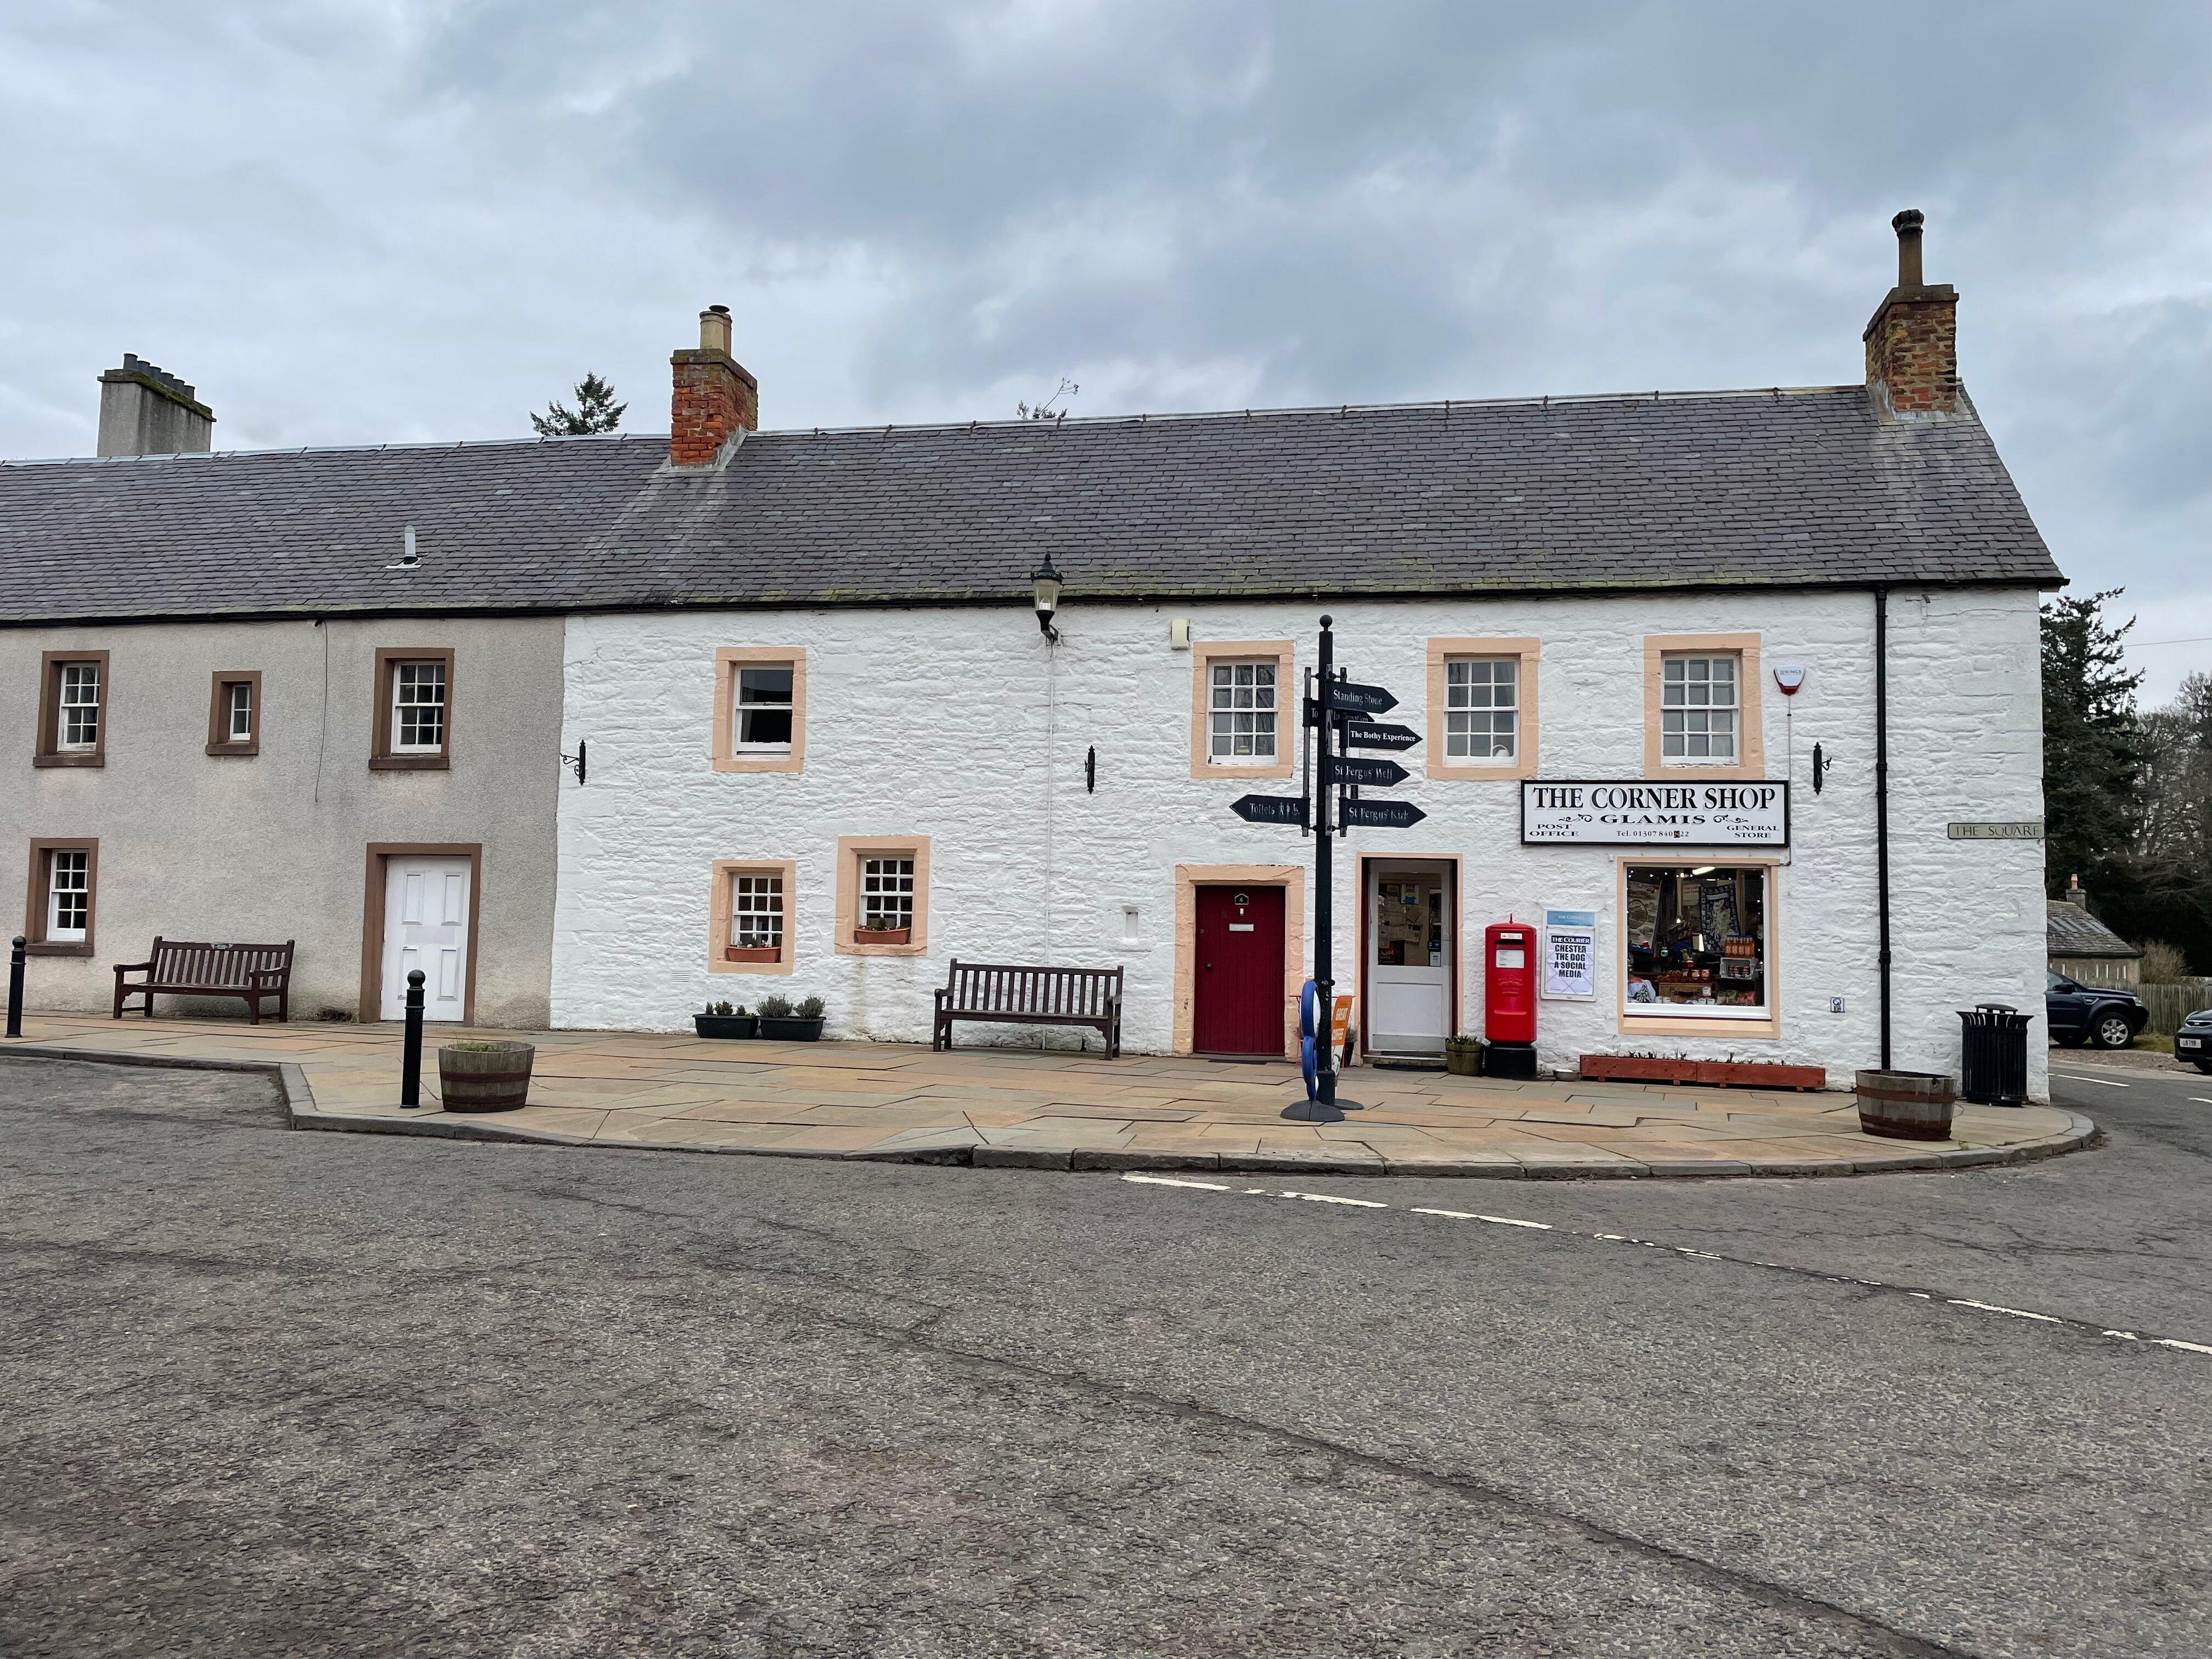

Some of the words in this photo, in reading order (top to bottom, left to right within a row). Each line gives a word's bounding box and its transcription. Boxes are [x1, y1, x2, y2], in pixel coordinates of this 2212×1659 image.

[1333, 689, 1363, 706] Standing
[1364, 693, 1383, 705] Stone
[1350, 730, 1362, 738] The
[1363, 731, 1381, 741] Bothy
[1383, 732, 1416, 742] Experience
[1335, 765, 1344, 775] St
[1375, 768, 1392, 778] Well
[1532, 786, 1584, 809] THE
[1590, 787, 1698, 810] CORNER
[1704, 787, 1775, 810] SHOP
[1249, 803, 1275, 815] Toilets
[1348, 807, 1358, 817] St
[1391, 809, 1409, 820] Kirk
[1600, 814, 1706, 825] GLAMIS
[1956, 826, 1979, 836] THE
[1988, 825, 2040, 837] SQUARE
[1555, 945, 1586, 953] CHESTER
[1560, 961, 1586, 969] SOCIAL
